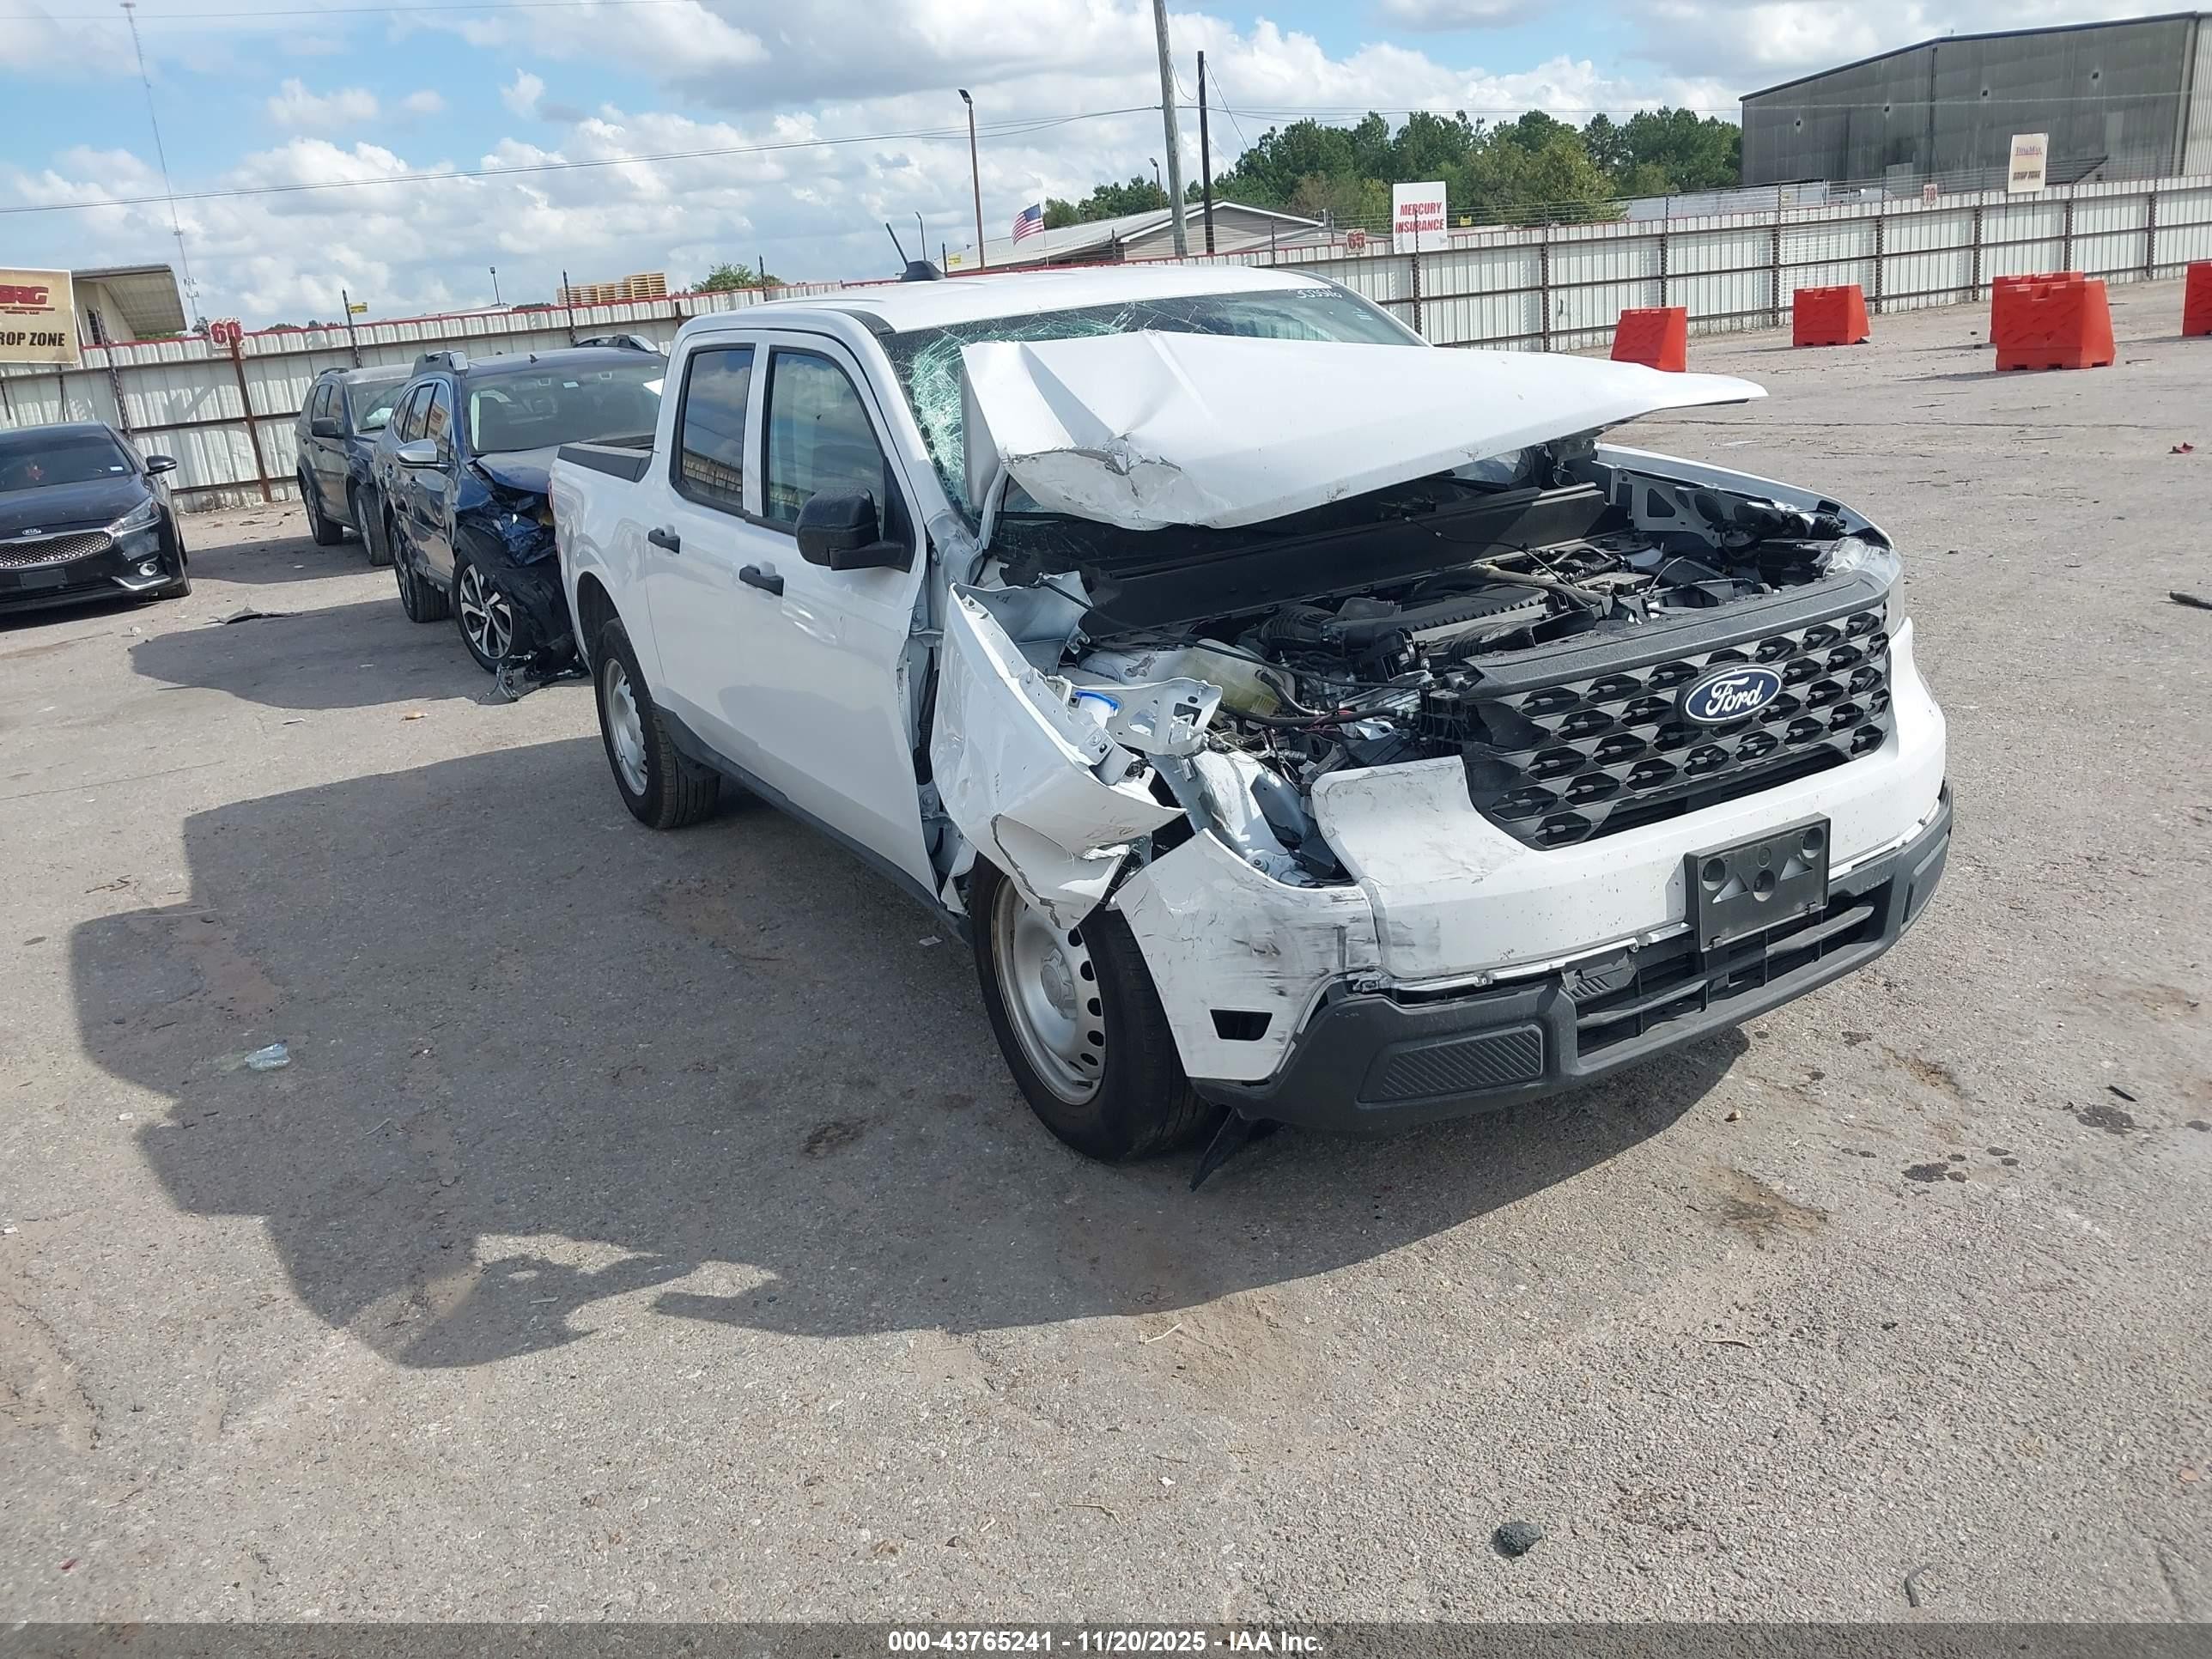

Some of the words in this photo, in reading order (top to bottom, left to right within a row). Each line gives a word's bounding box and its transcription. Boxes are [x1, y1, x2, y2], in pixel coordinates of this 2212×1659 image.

[1401, 202, 1442, 216] MERCURY
[1395, 218, 1444, 234] INSURANCE
[29, 332, 65, 347] ZONE
[211, 322, 241, 343] 60
[1705, 677, 1765, 715] Ford
